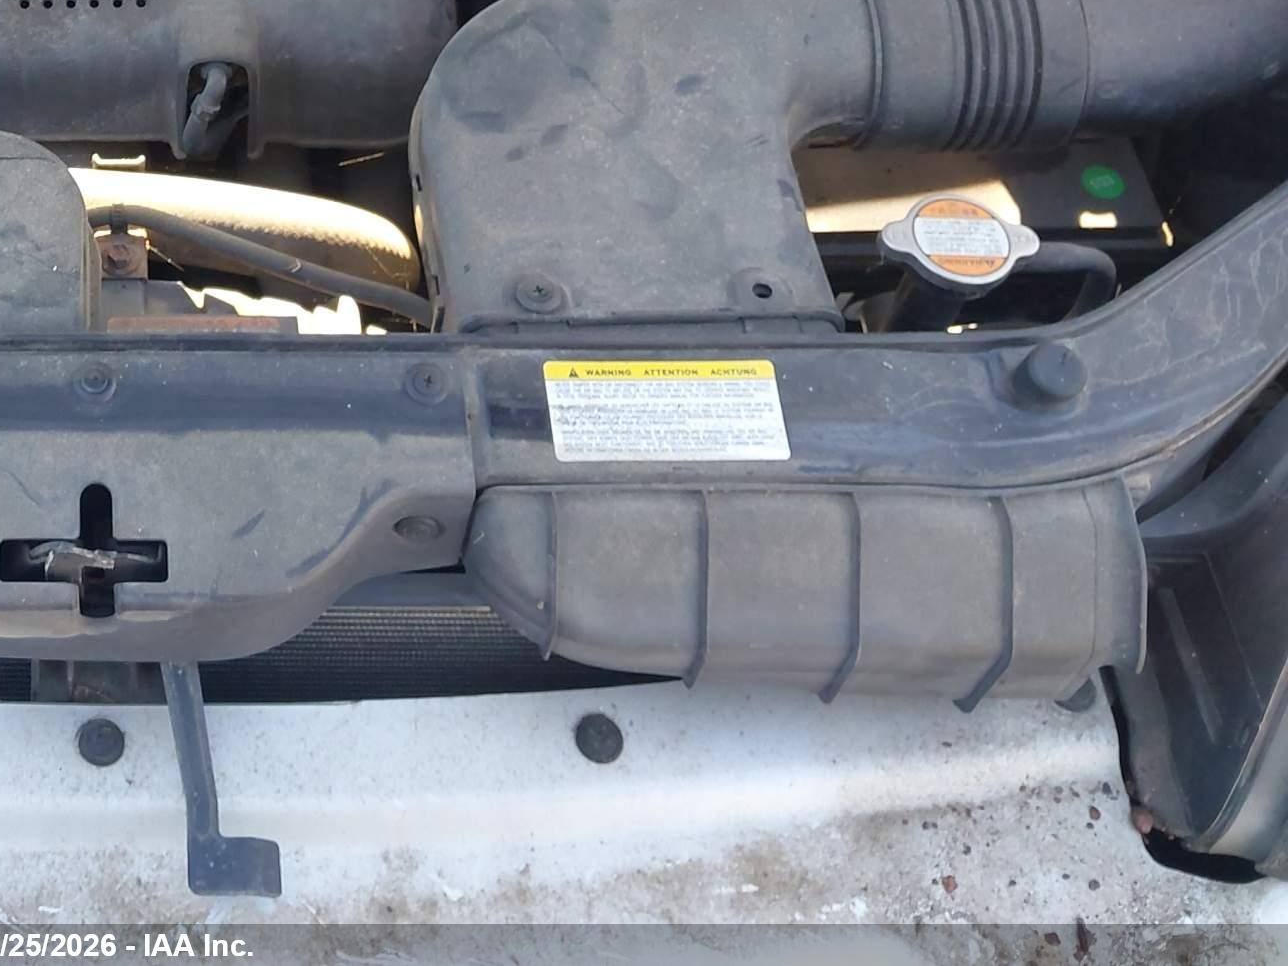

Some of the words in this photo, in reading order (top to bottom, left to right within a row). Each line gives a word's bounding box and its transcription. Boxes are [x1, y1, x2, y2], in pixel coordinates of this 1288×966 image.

[585, 368, 632, 377] WARNING
[643, 368, 699, 377] ATTENTION
[710, 368, 758, 377] ACHTUNG
